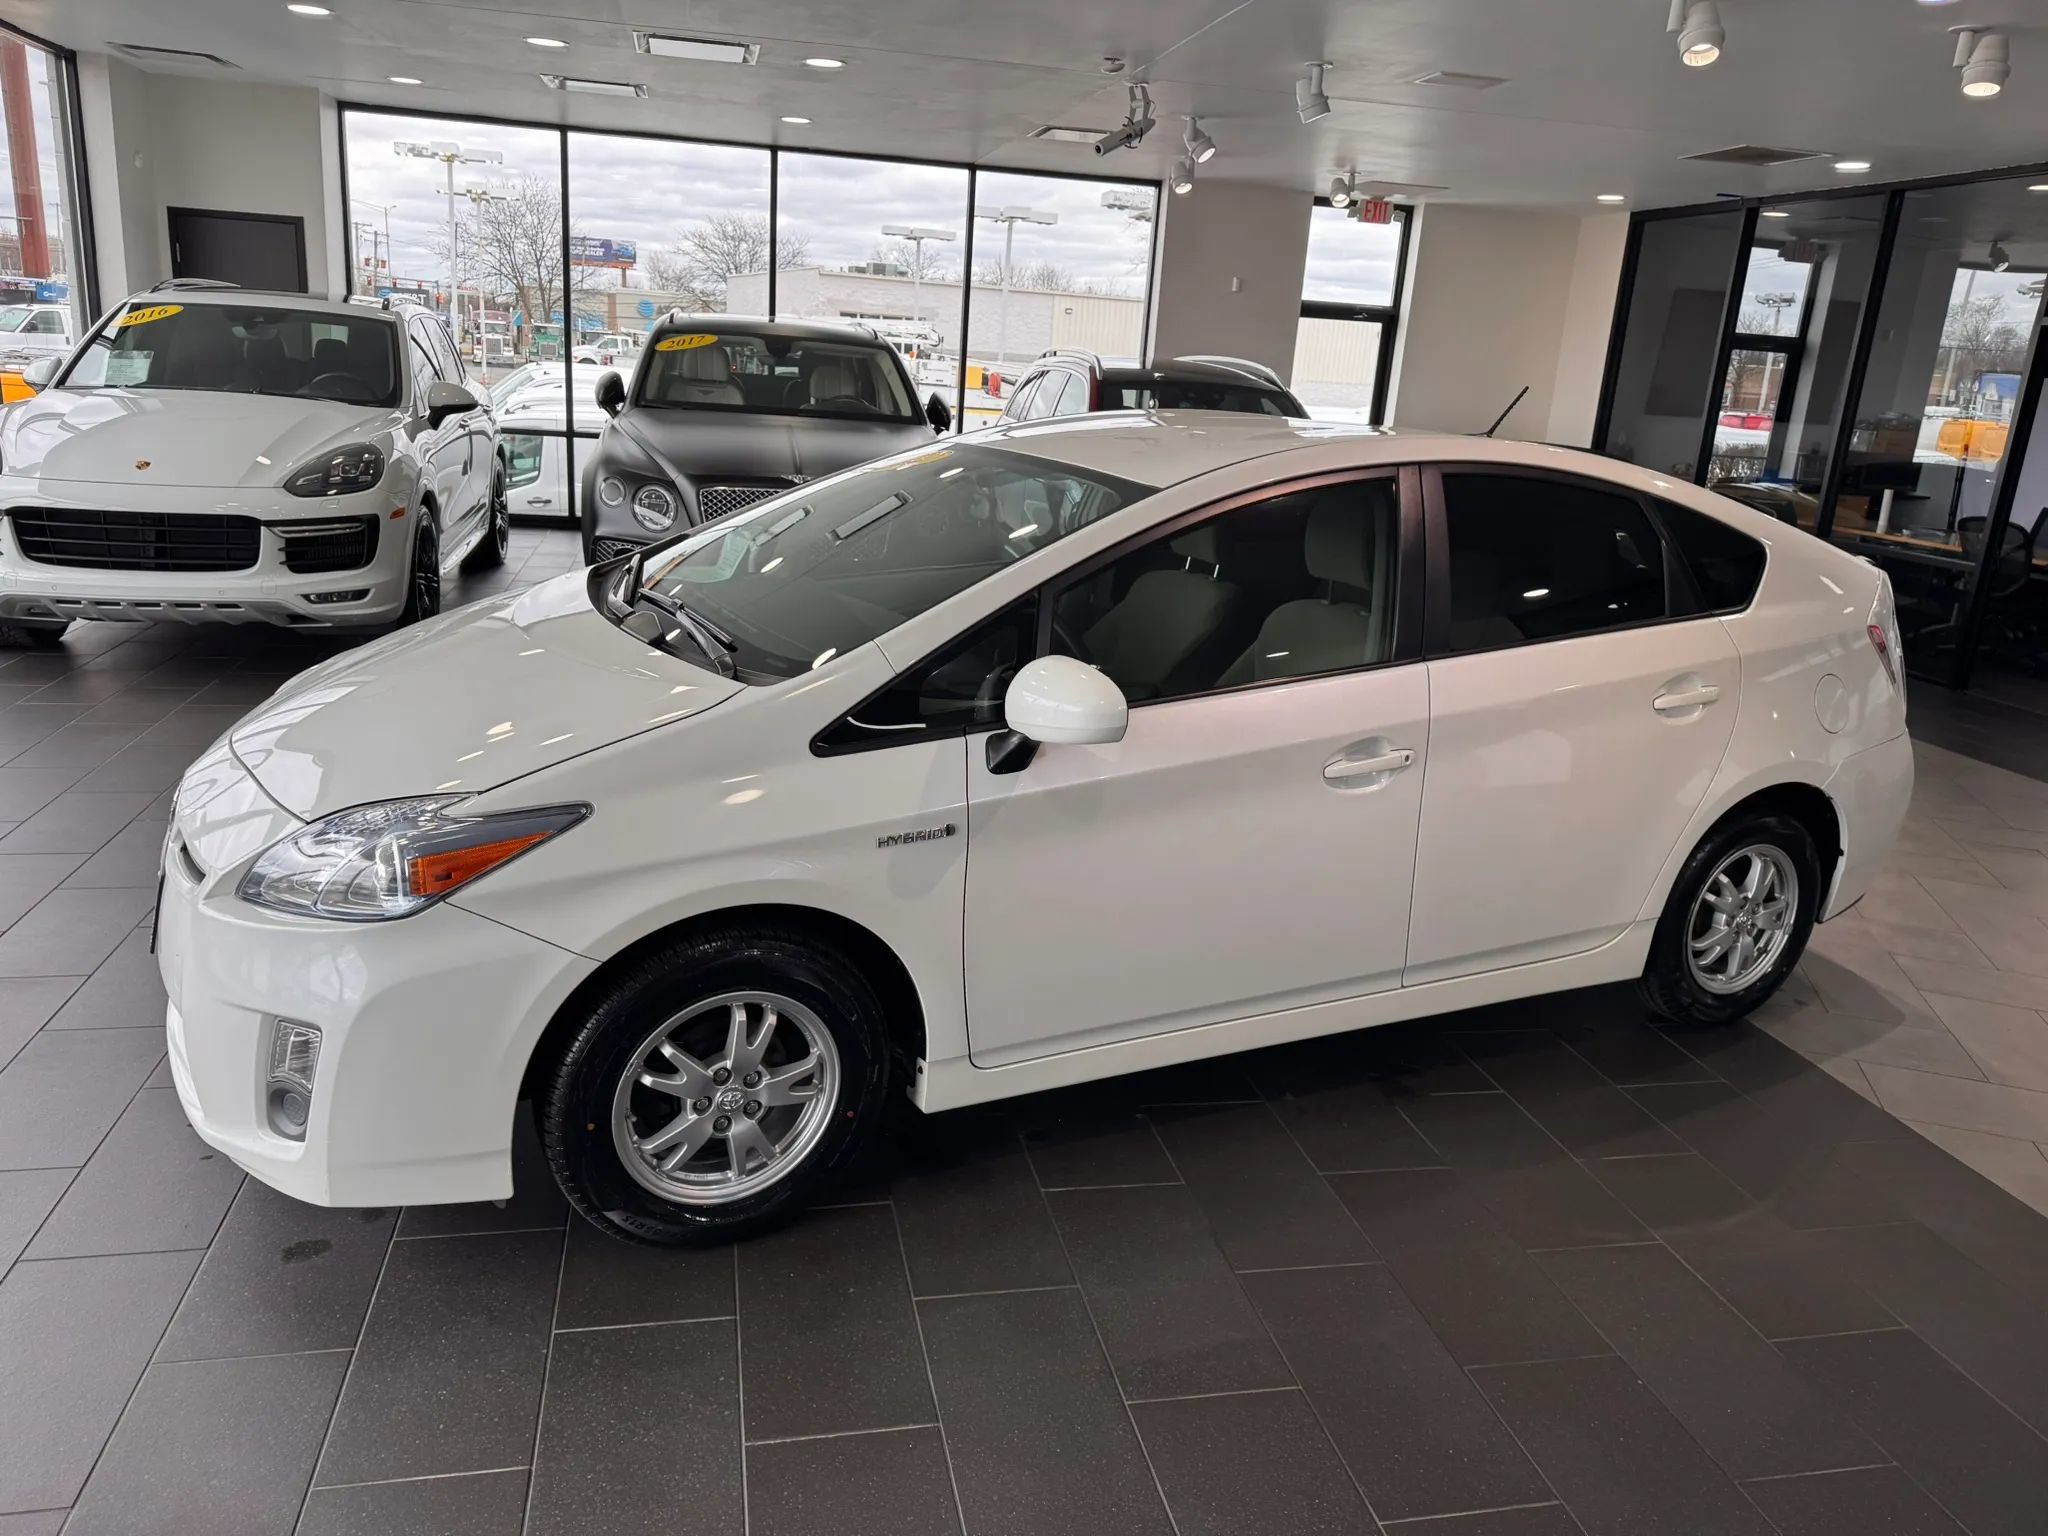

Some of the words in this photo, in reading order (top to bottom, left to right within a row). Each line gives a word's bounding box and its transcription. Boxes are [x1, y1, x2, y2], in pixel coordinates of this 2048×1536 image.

[1364, 200, 1390, 223] EXIT
[126, 307, 168, 323] 2016
[667, 336, 705, 349] 2017
[877, 827, 944, 848] HYBRID
